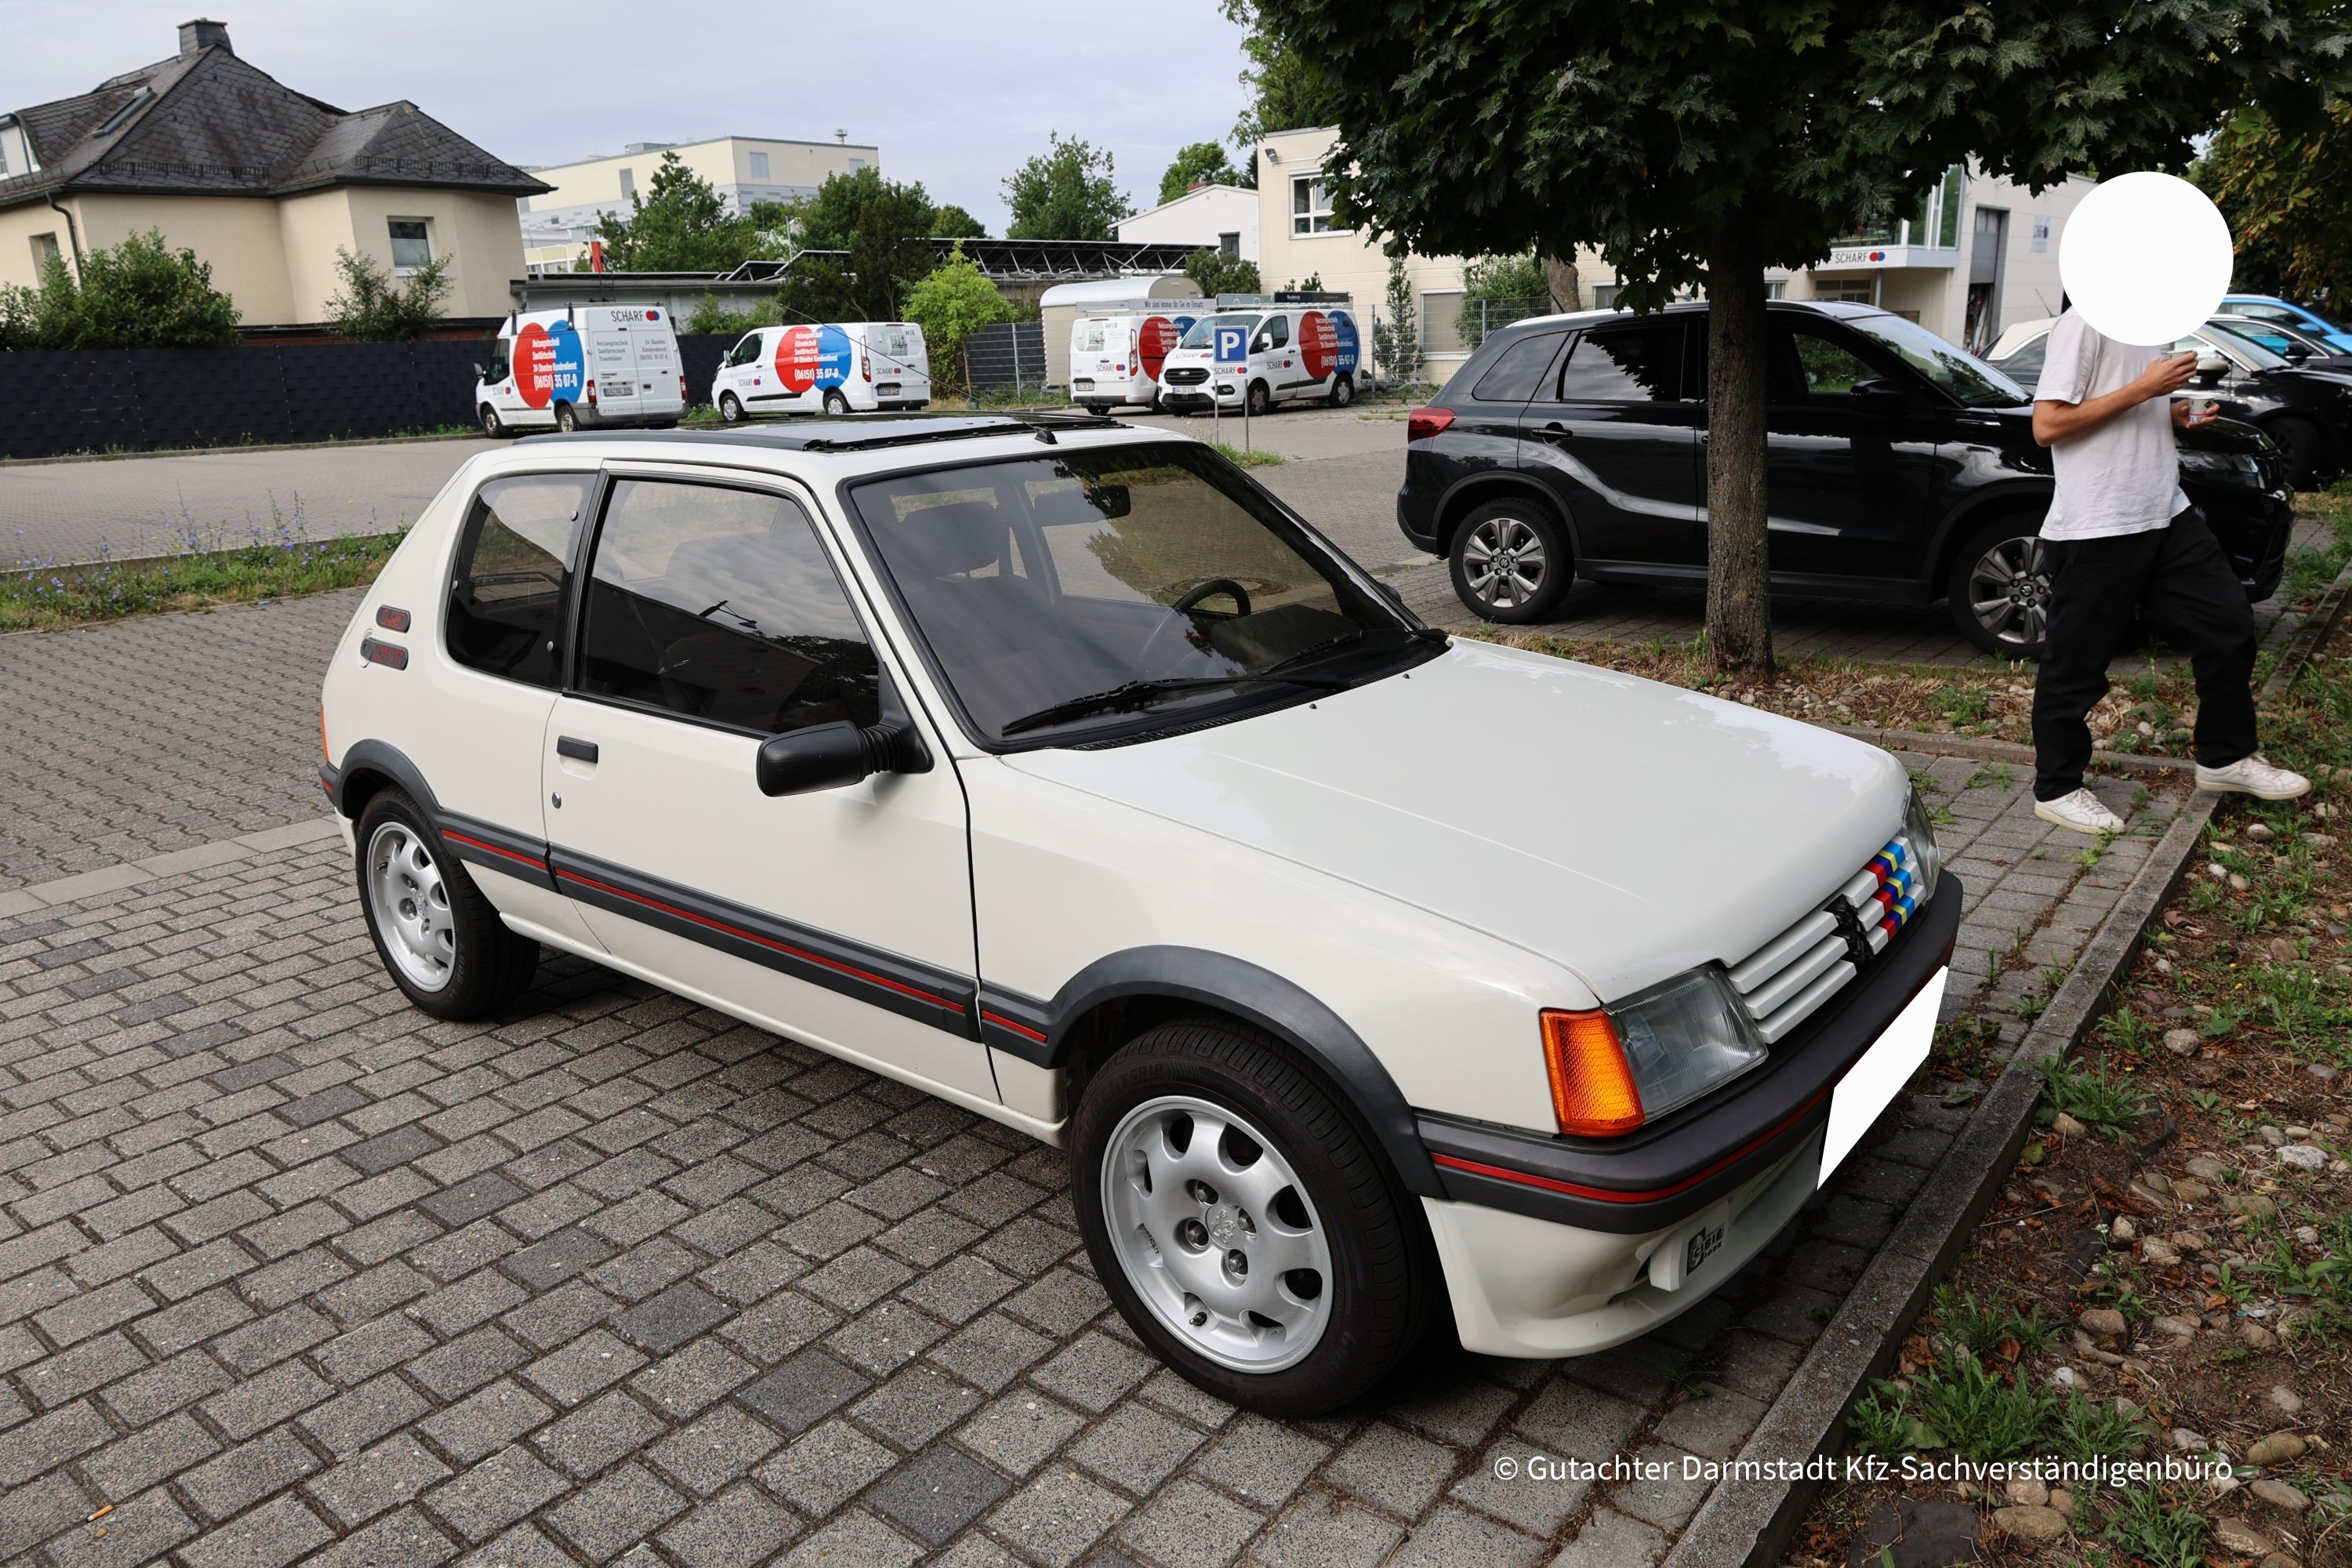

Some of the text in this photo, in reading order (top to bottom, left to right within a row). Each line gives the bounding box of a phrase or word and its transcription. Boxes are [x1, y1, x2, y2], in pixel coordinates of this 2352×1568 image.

[1835, 252, 1867, 263] SCHARF
[611, 310, 643, 322] SCHARF
[1221, 332, 1240, 358] P
[1267, 361, 1283, 370] SCHARF
[1321, 354, 1338, 368] (06151)
[1096, 364, 1115, 372] SCHARF
[794, 368, 839, 381] (06151) 35 07-0
[534, 374, 577, 390] (06151) 35 07-0
